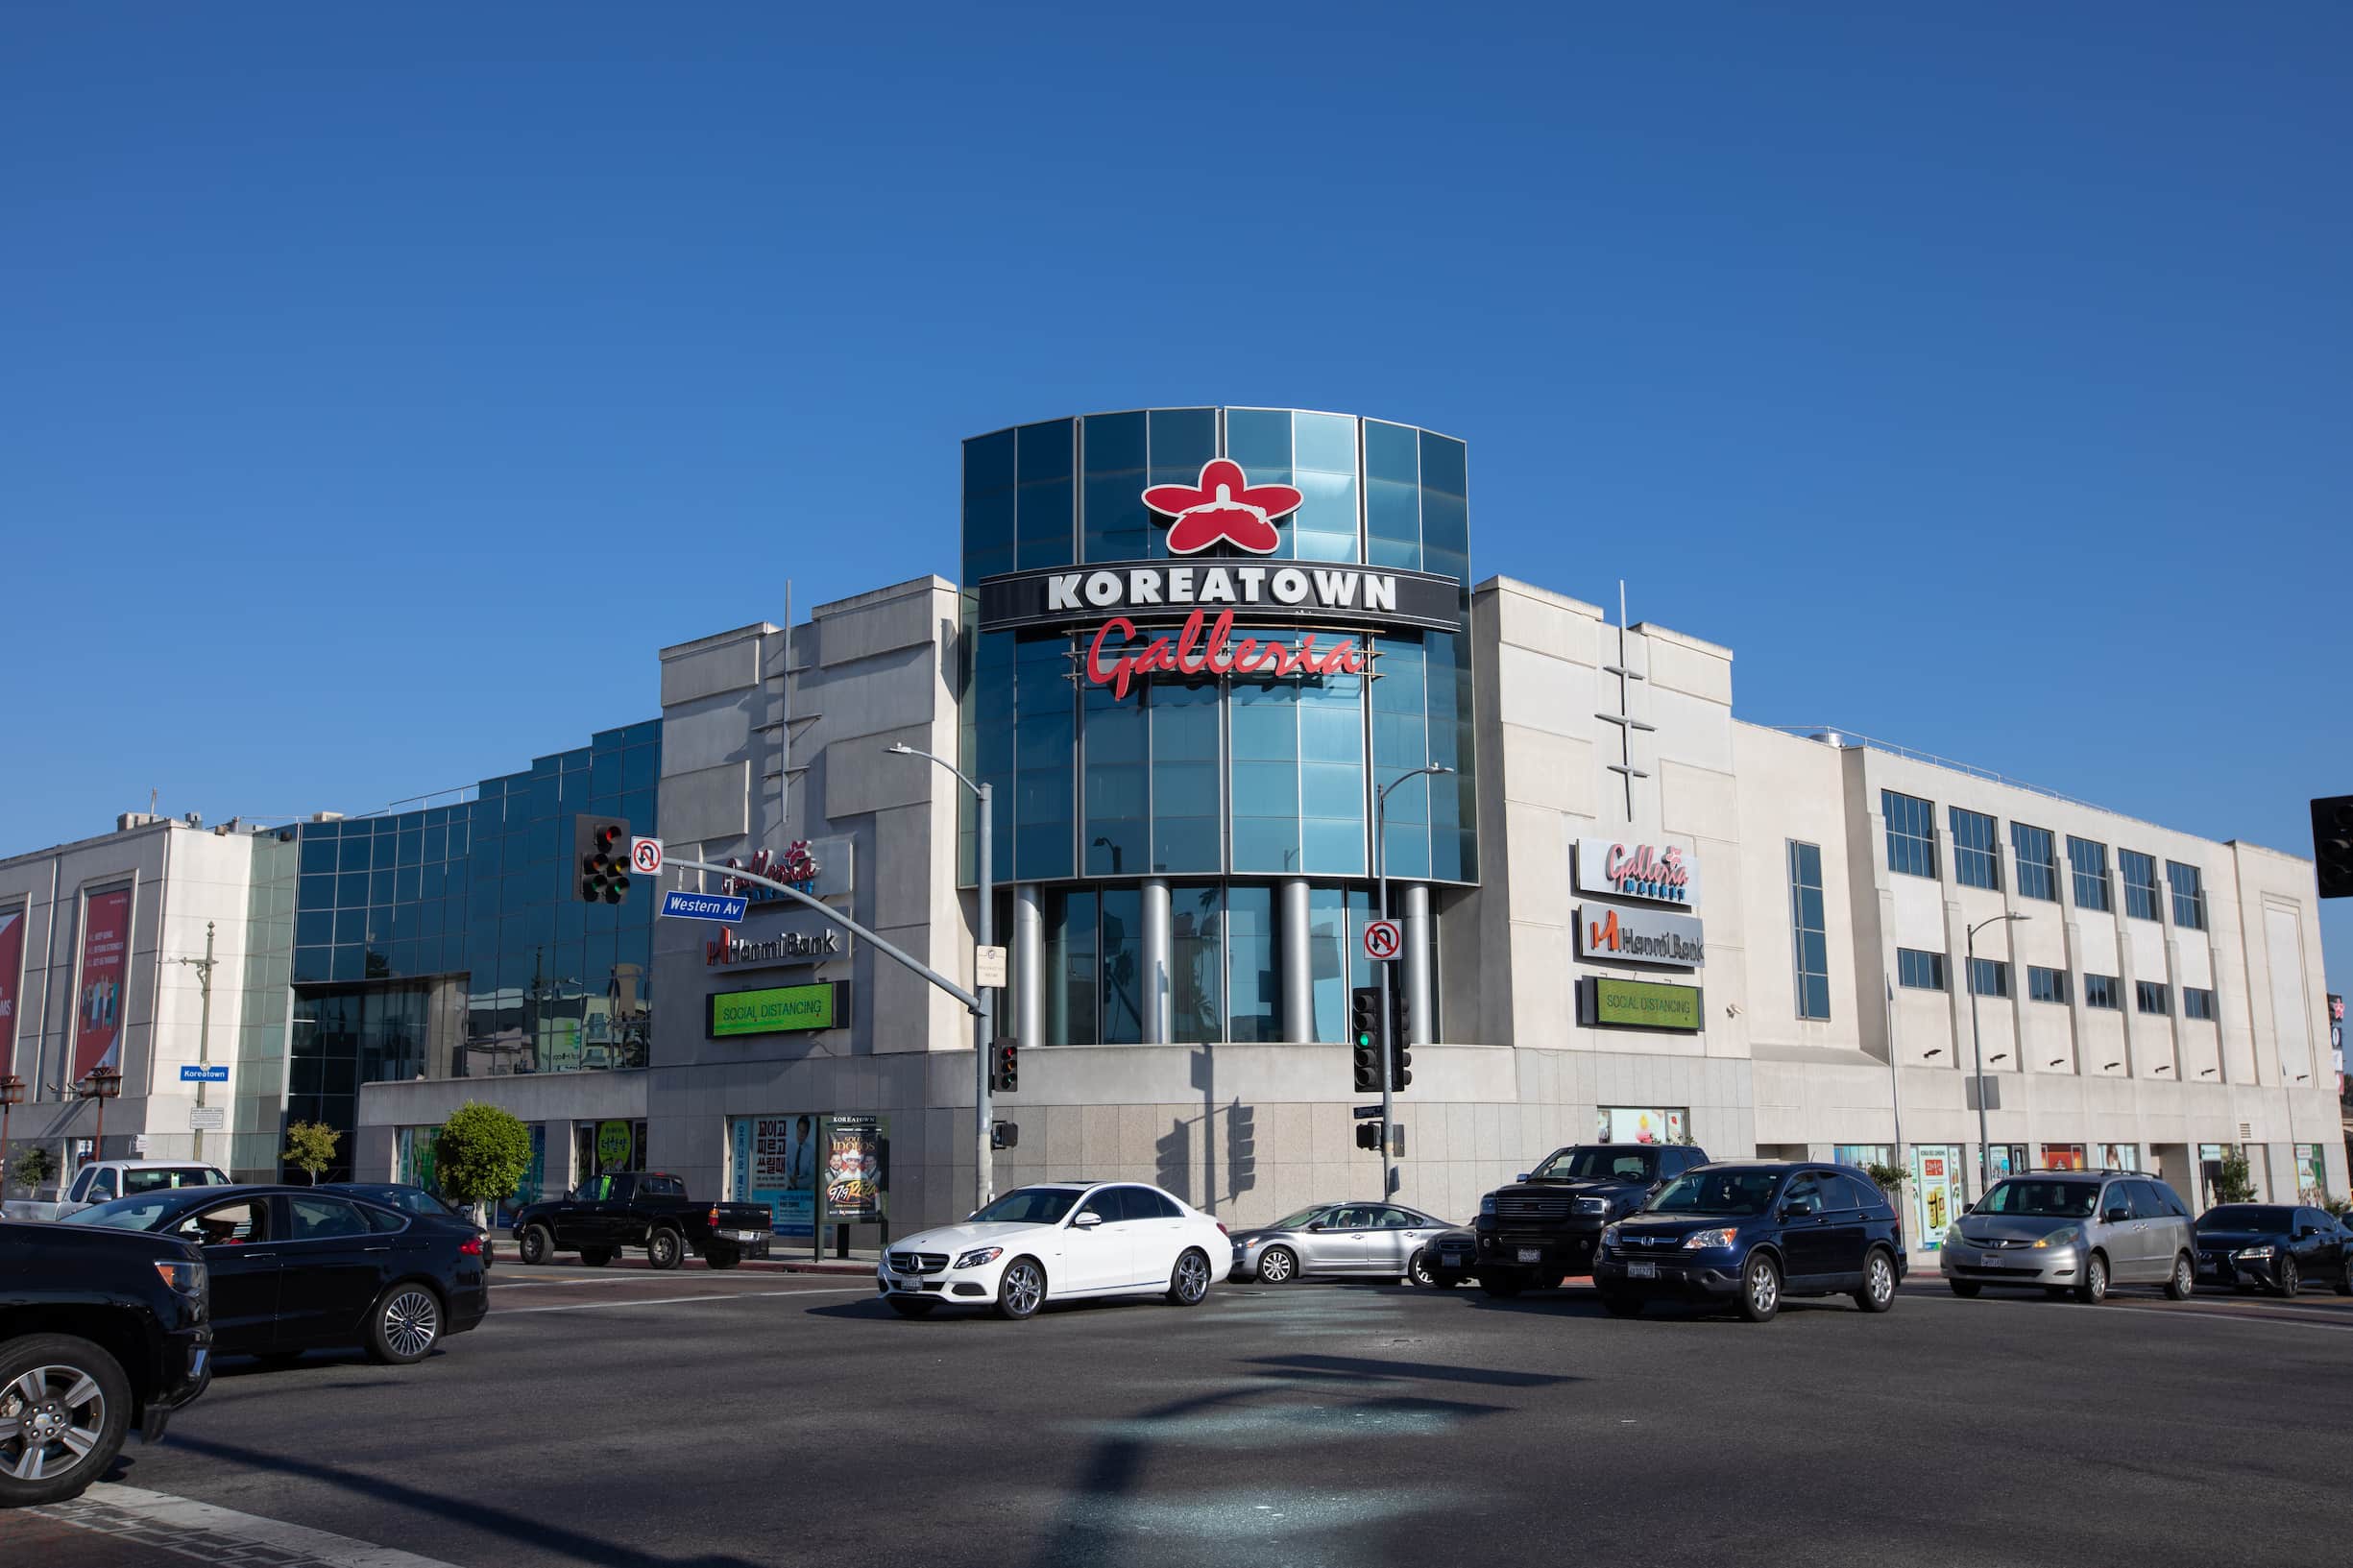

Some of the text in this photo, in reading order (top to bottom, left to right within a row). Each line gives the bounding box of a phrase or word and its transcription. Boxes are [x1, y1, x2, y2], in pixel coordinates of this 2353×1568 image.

[1048, 567, 1396, 611] KOREATOWN
[1086, 608, 1367, 702] Galleria
[1608, 844, 1689, 889] Galleria
[669, 897, 740, 915] Western Av
[730, 929, 837, 963] Hanmi Bank
[1622, 928, 1705, 959] Hanmi Bank
[723, 1000, 822, 1021] SOCIAL DISTANCING
[1607, 994, 1690, 1014] SOCIAL DISTANCING
[184, 1070, 226, 1078] Koreatown
